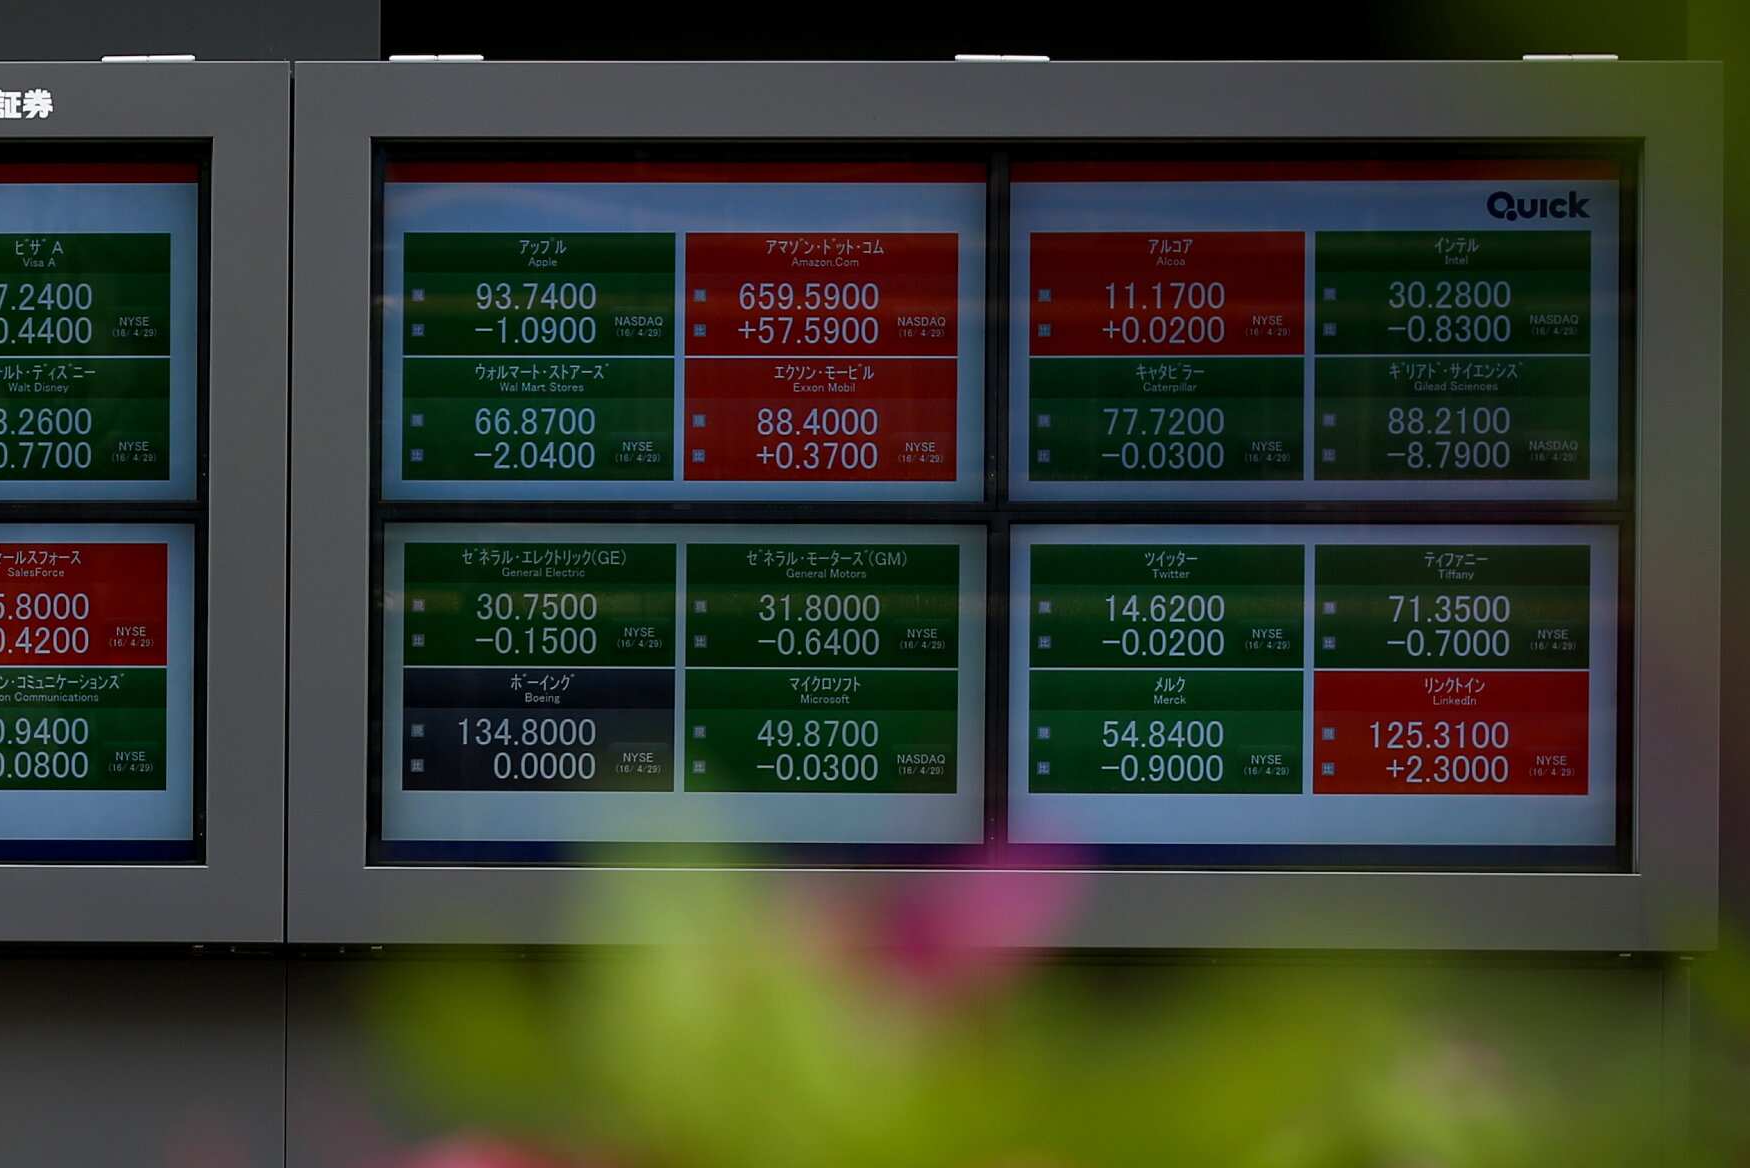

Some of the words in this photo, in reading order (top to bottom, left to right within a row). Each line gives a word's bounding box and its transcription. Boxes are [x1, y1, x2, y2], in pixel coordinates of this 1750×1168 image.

[527, 256, 559, 270] Apple
[1155, 254, 1187, 267] Alcoa
[476, 282, 597, 310] 93.7400
[739, 282, 879, 311] 659.5900
[1105, 281, 1225, 310] 11.1700
[1388, 280, 1511, 309] 30.2800
[119, 316, 150, 327] NYSE
[474, 316, 596, 344] -1.0900
[614, 315, 664, 327] NASDAQ
[737, 316, 879, 345] +57.5900
[897, 316, 946, 327] NASDAQ
[1102, 315, 1225, 344] +0.0200
[1387, 314, 1511, 343] -0.8300
[1141, 379, 1198, 393] Caterpillar
[475, 407, 596, 435] 66.8700
[757, 407, 878, 436] 88.4000
[1103, 407, 1225, 436] 77.7200
[1388, 407, 1510, 435] 88.2100
[118, 440, 150, 452] NYSE
[473, 441, 595, 469] -2.0400
[622, 441, 653, 452] NYSE
[756, 441, 878, 470] +0.3700
[905, 441, 936, 453] NYSE
[1101, 441, 1225, 470] -0.0300
[1386, 440, 1510, 469] -8.7900
[501, 566, 543, 577] General
[545, 566, 586, 578] Electric
[785, 567, 827, 579] General
[829, 568, 867, 579] Motors
[1151, 568, 1191, 580] Twitter
[476, 593, 598, 621] 30.7500
[758, 593, 880, 622] 31.8000
[1105, 594, 1225, 623] 14.6200
[1388, 595, 1511, 623] 71.3500
[116, 625, 147, 637] NYSE
[475, 626, 597, 655] -0.1500
[623, 626, 655, 638] NYSE
[757, 628, 880, 656] -0.6400
[906, 628, 938, 639] NYSE
[1102, 628, 1225, 657] -0.0200
[1252, 628, 1283, 640] NYSE
[1386, 629, 1510, 657] -0.7000
[524, 691, 561, 705] Boeing
[800, 693, 851, 705] Microsoft
[1153, 693, 1187, 705] Merck
[1432, 693, 1477, 706] LinkedIn
[458, 717, 596, 746] 134.8000
[757, 719, 879, 748] 49.8700
[1102, 720, 1224, 748] 54.8400
[1369, 720, 1509, 749] 125.3100
[115, 751, 146, 762] NYSE
[493, 751, 596, 780] 0.0000
[622, 752, 654, 763] NYSE
[756, 753, 879, 782] -0.0300
[897, 753, 946, 765] NASDAQ
[1100, 754, 1224, 782] -0.9000
[1250, 754, 1282, 765] NYSE
[1385, 754, 1509, 783] +2.3000
[1536, 755, 1567, 766] NYSE
